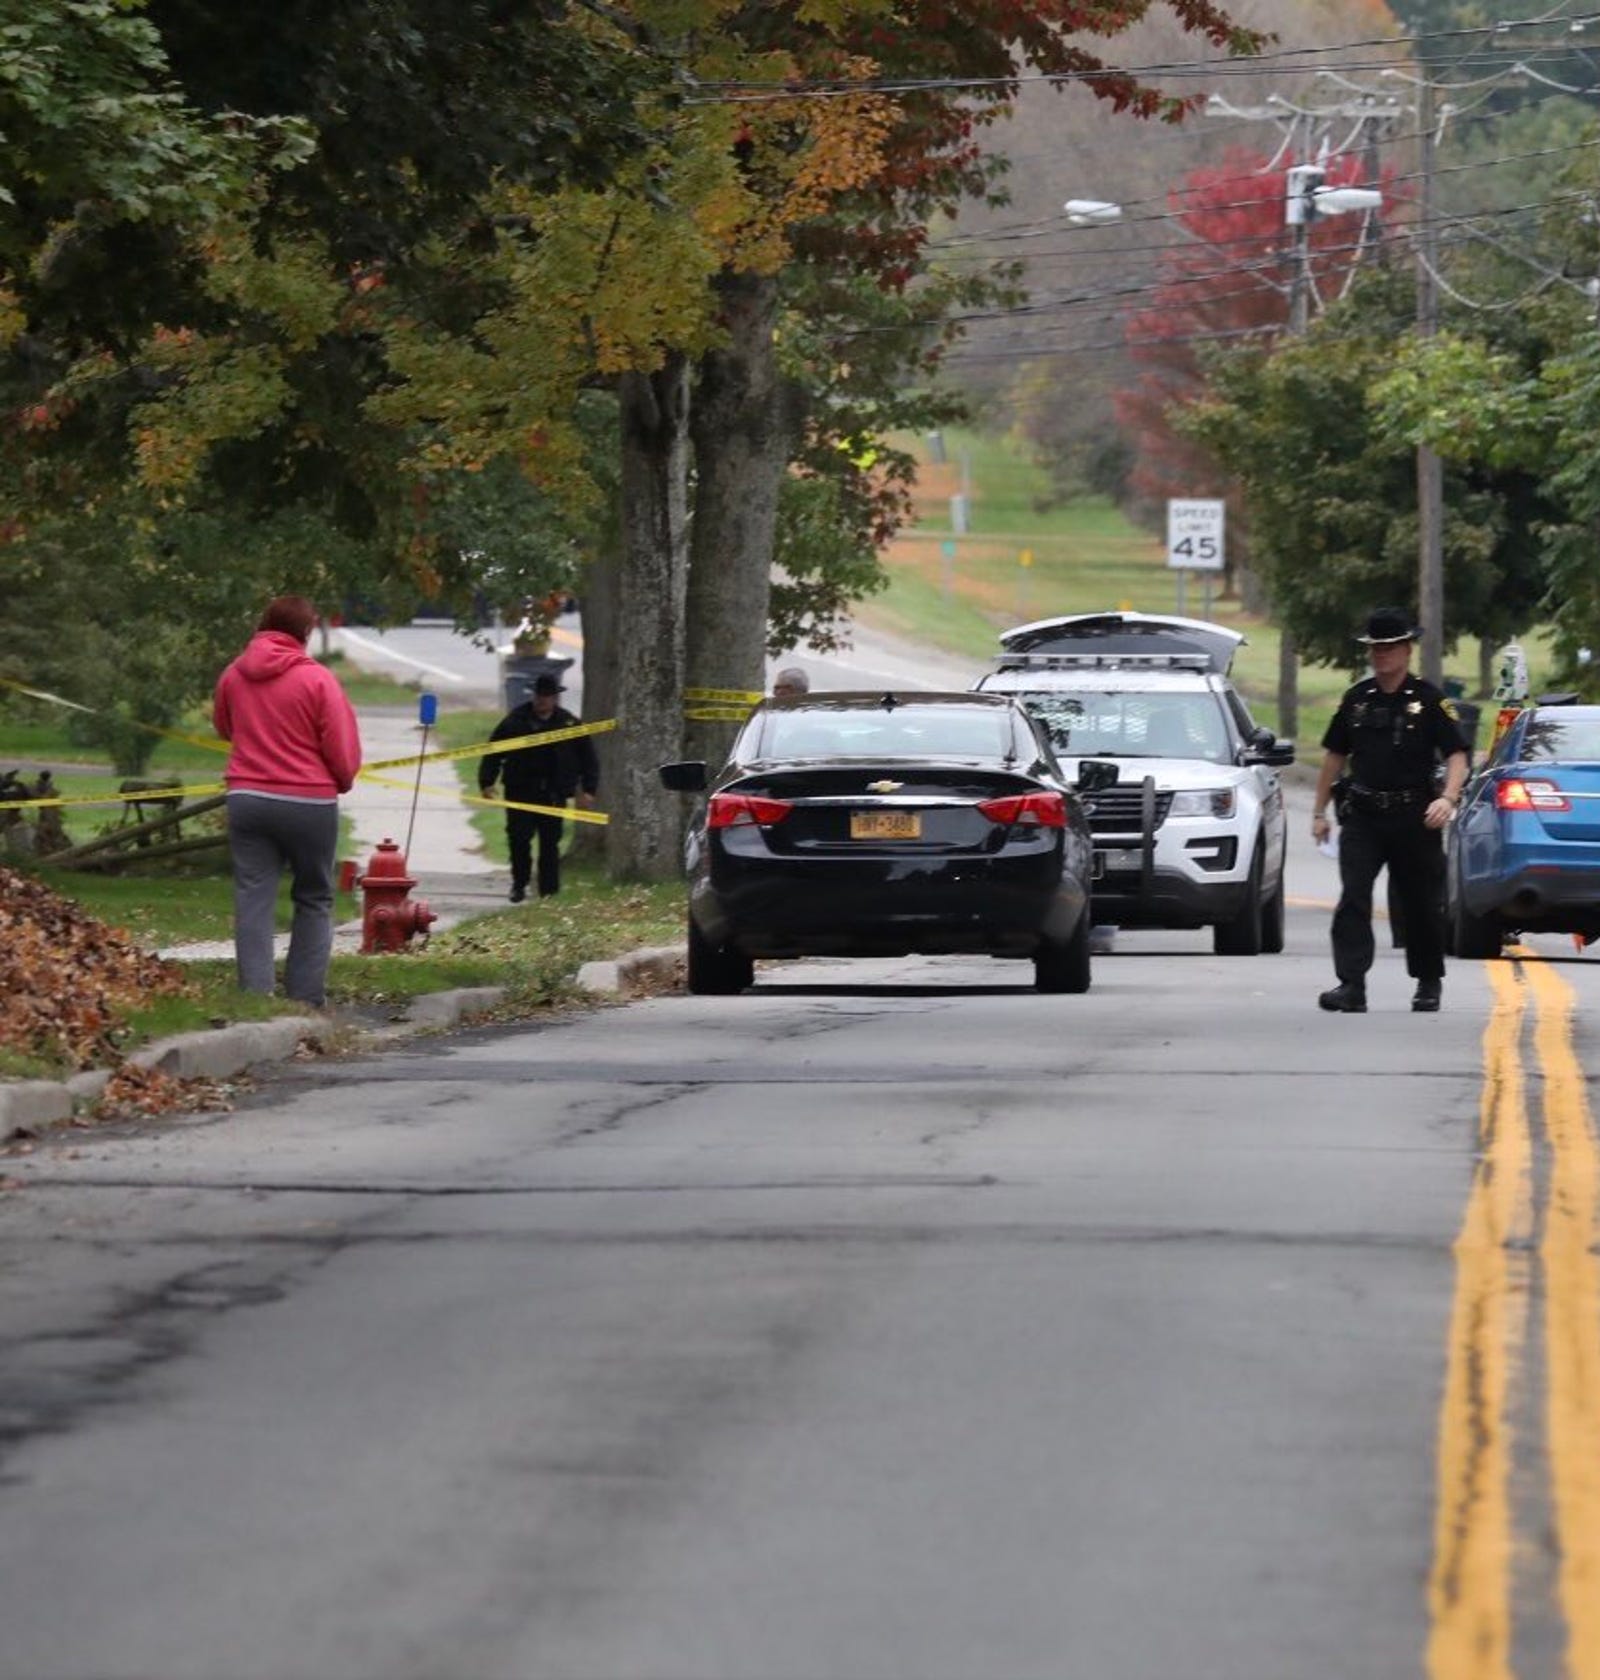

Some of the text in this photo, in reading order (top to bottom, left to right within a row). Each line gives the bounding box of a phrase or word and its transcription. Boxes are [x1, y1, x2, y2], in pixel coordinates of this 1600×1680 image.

[1173, 508, 1219, 519] SPEED
[1178, 522, 1212, 534] LIMIT
[1173, 537, 1217, 559] 45
